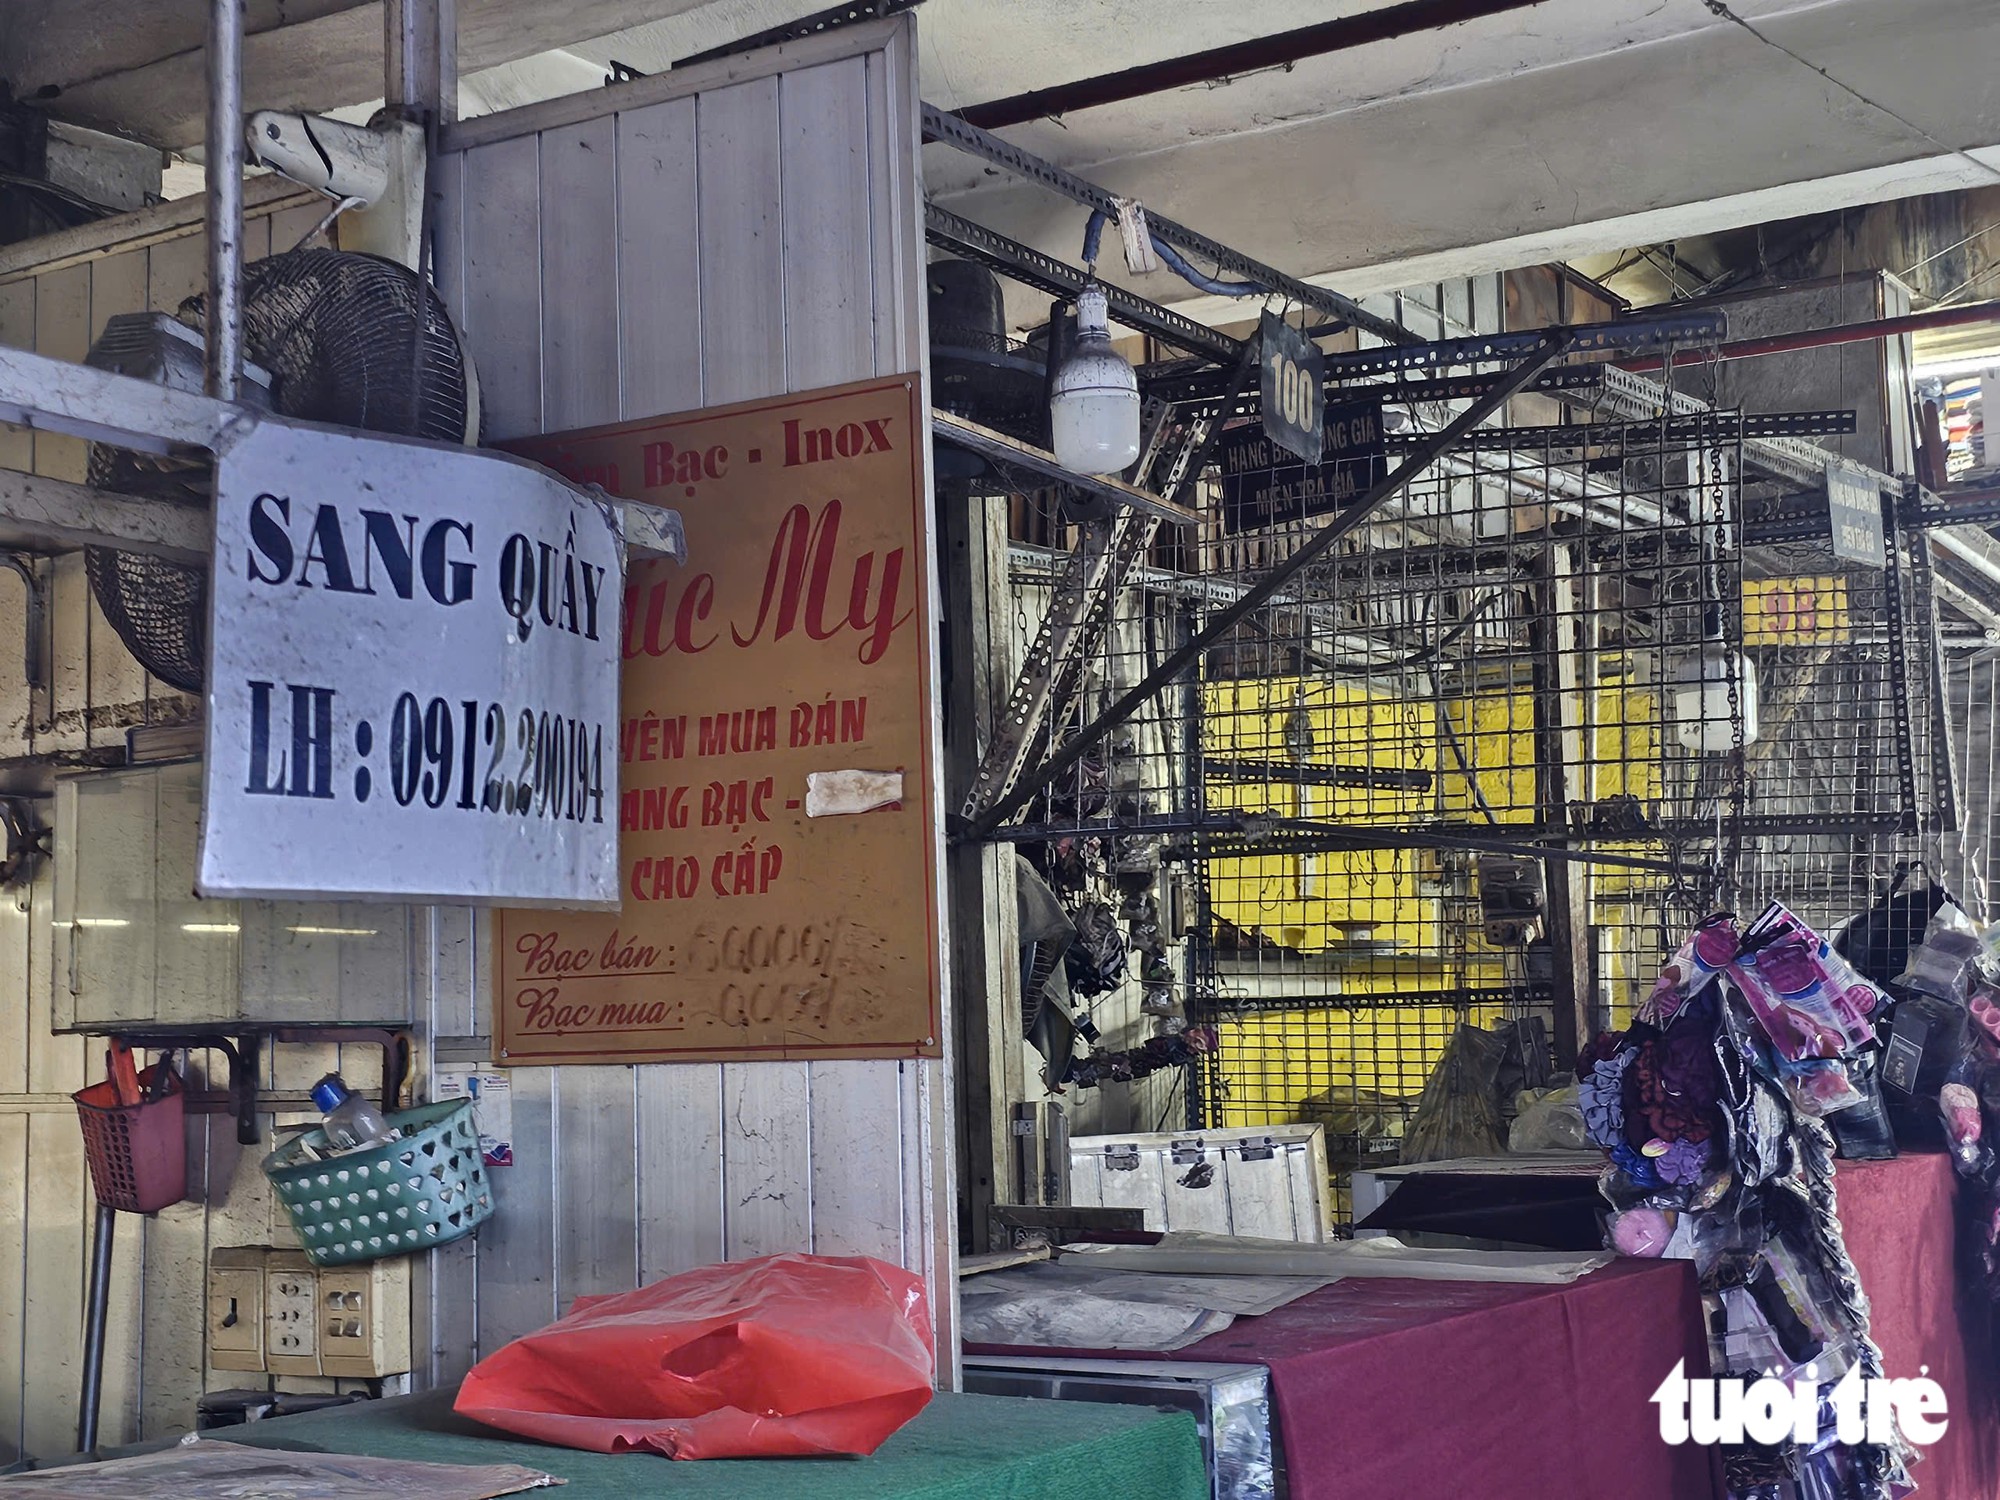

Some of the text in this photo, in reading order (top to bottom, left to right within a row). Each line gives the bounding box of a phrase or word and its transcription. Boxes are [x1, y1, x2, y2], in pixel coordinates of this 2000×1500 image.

[1270, 352, 1314, 433] 100
[1351, 408, 1377, 444] GIÁ
[642, 440, 729, 497] Bạc
[781, 417, 894, 468] Inox
[246, 493, 606, 644] SANG QUẦY
[732, 498, 914, 665] My
[389, 690, 605, 824] 0912.200194
[621, 692, 867, 763] YÊN MUA BÁN
[620, 786, 690, 832] ANG
[702, 776, 773, 833] BẠC
[630, 836, 783, 900] CAO CẤP
